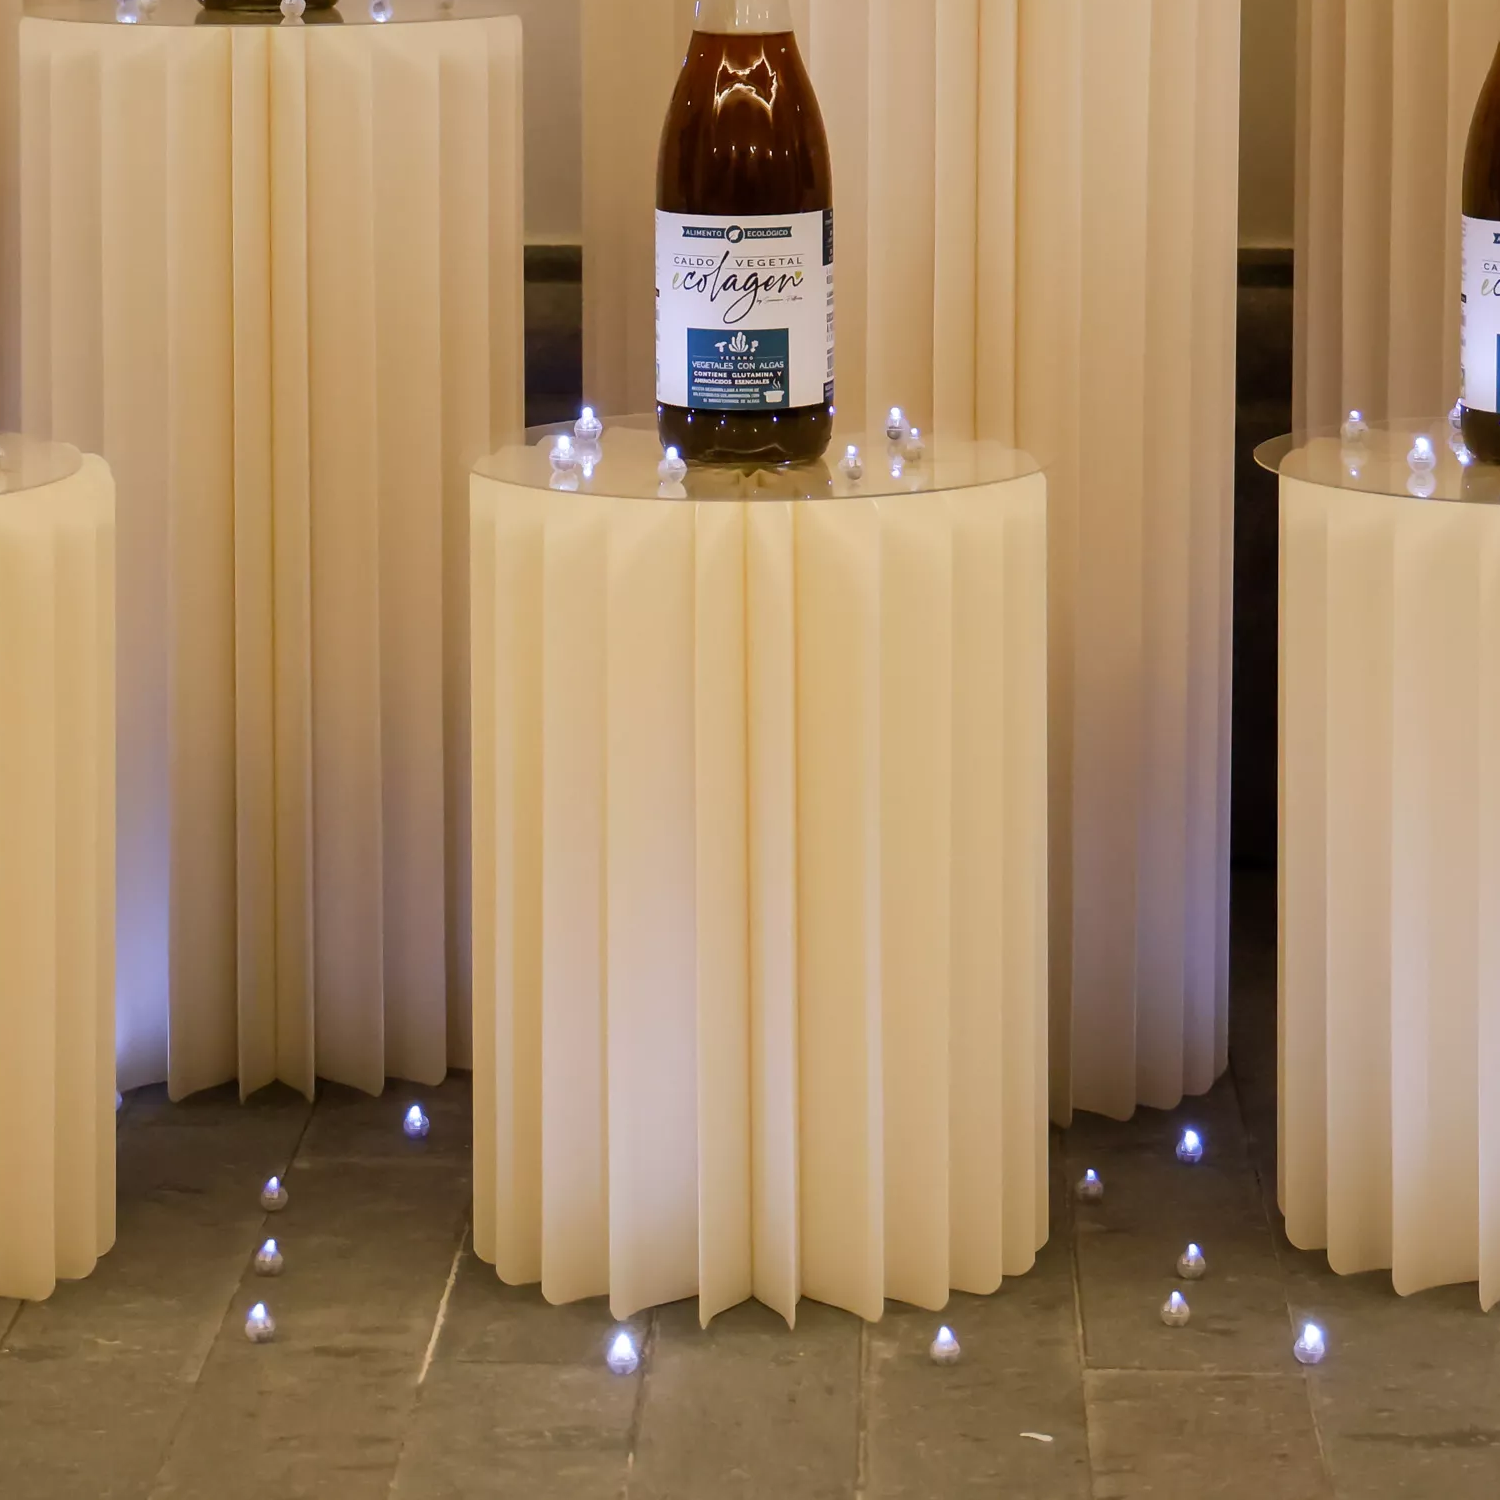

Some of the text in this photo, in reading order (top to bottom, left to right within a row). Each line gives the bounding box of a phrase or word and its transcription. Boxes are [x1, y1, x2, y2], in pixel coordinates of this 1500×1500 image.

[747, 229, 788, 237] ECOLÓGICO
[674, 257, 803, 267] CALDO VEGETAL
[692, 360, 733, 369] VEGETALES
[760, 361, 784, 369] ALGAS
